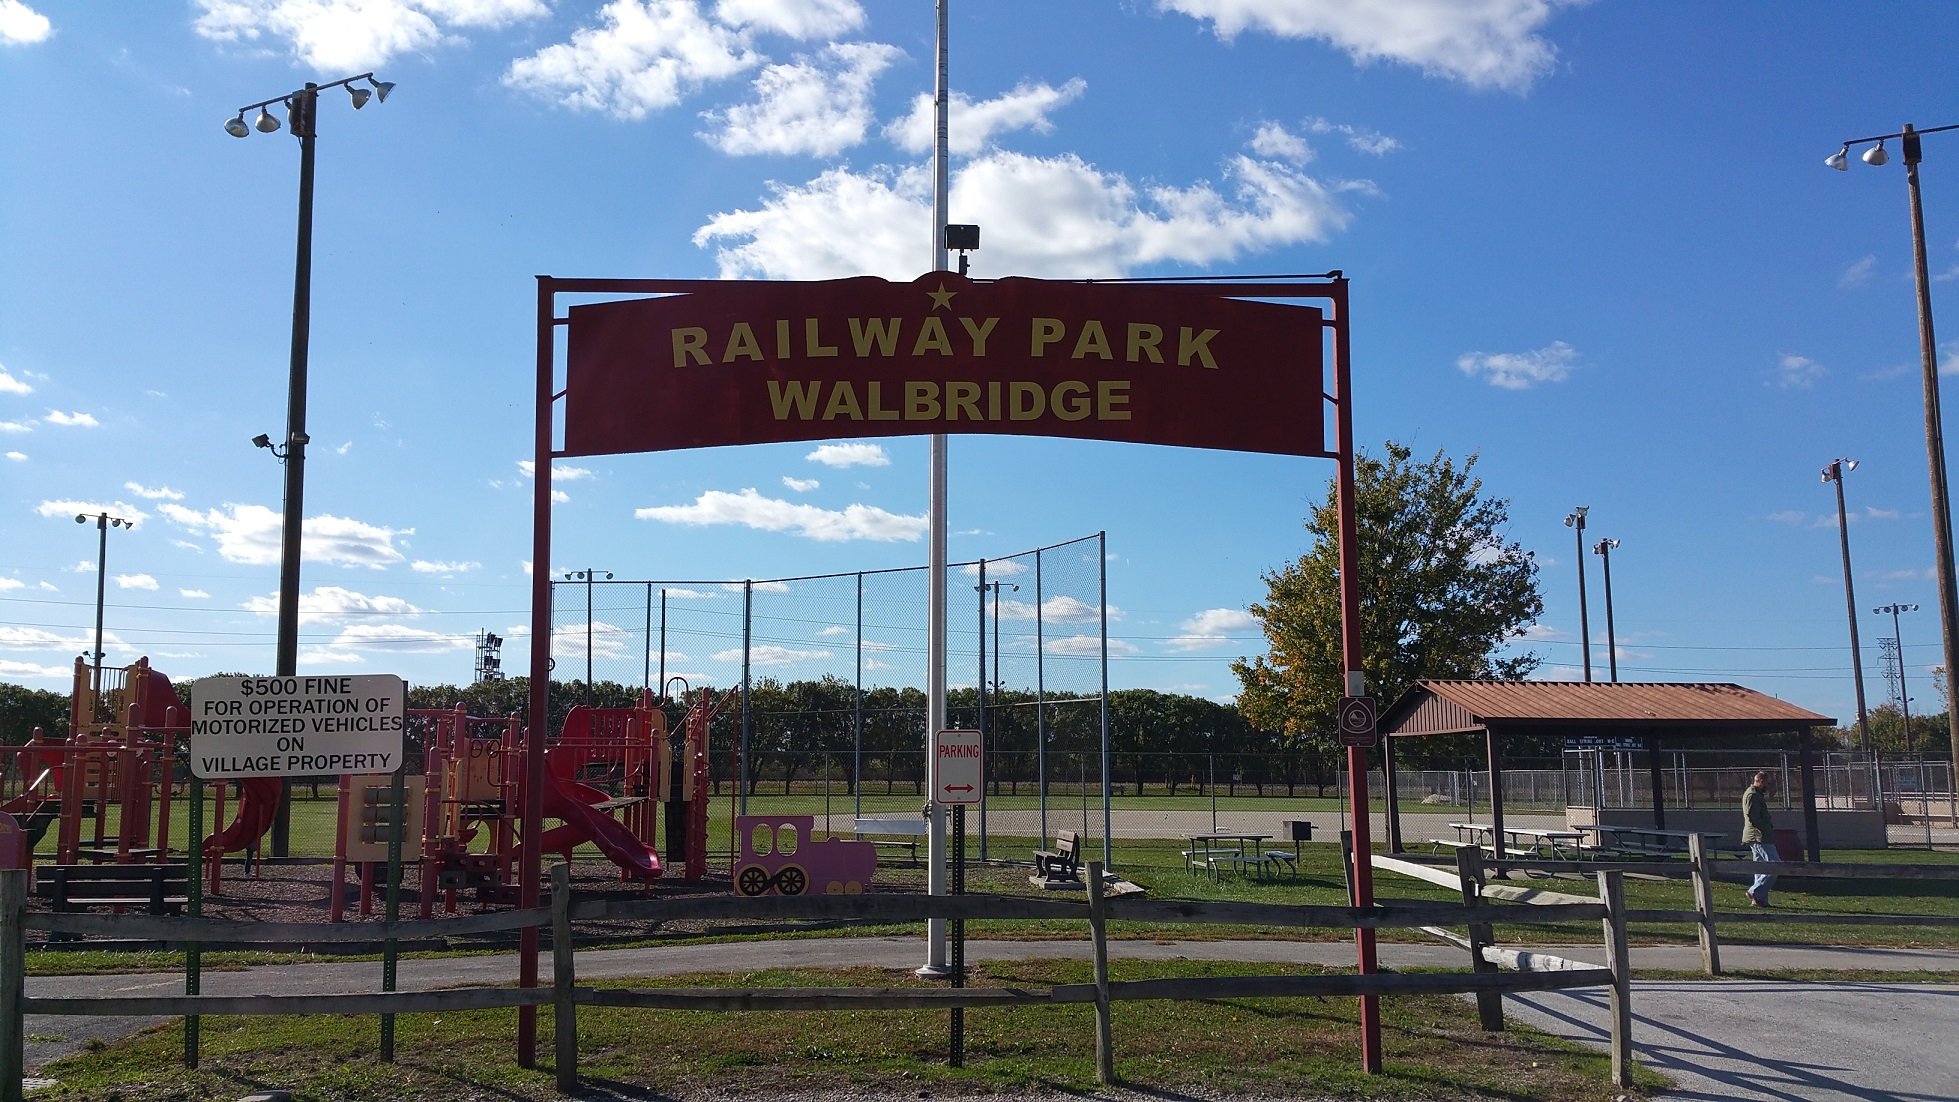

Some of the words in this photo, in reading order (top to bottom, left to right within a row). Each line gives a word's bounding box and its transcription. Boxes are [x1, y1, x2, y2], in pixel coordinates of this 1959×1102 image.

[671, 317, 1000, 368] RAILWAY
[1031, 317, 1221, 369] PARK
[766, 380, 1132, 421] WALBRIDGE
[240, 679, 297, 697] $500
[305, 678, 351, 694] FINE
[204, 700, 242, 716] FOR
[249, 698, 359, 716] OPERATION
[365, 697, 390, 713] OF
[191, 718, 305, 735] MOTORIZED
[311, 716, 403, 733] VEHICLES
[276, 736, 304, 752] ON
[940, 744, 979, 758] PARKING
[202, 756, 281, 772] VILLAGE
[287, 753, 391, 770] PROPERTY
